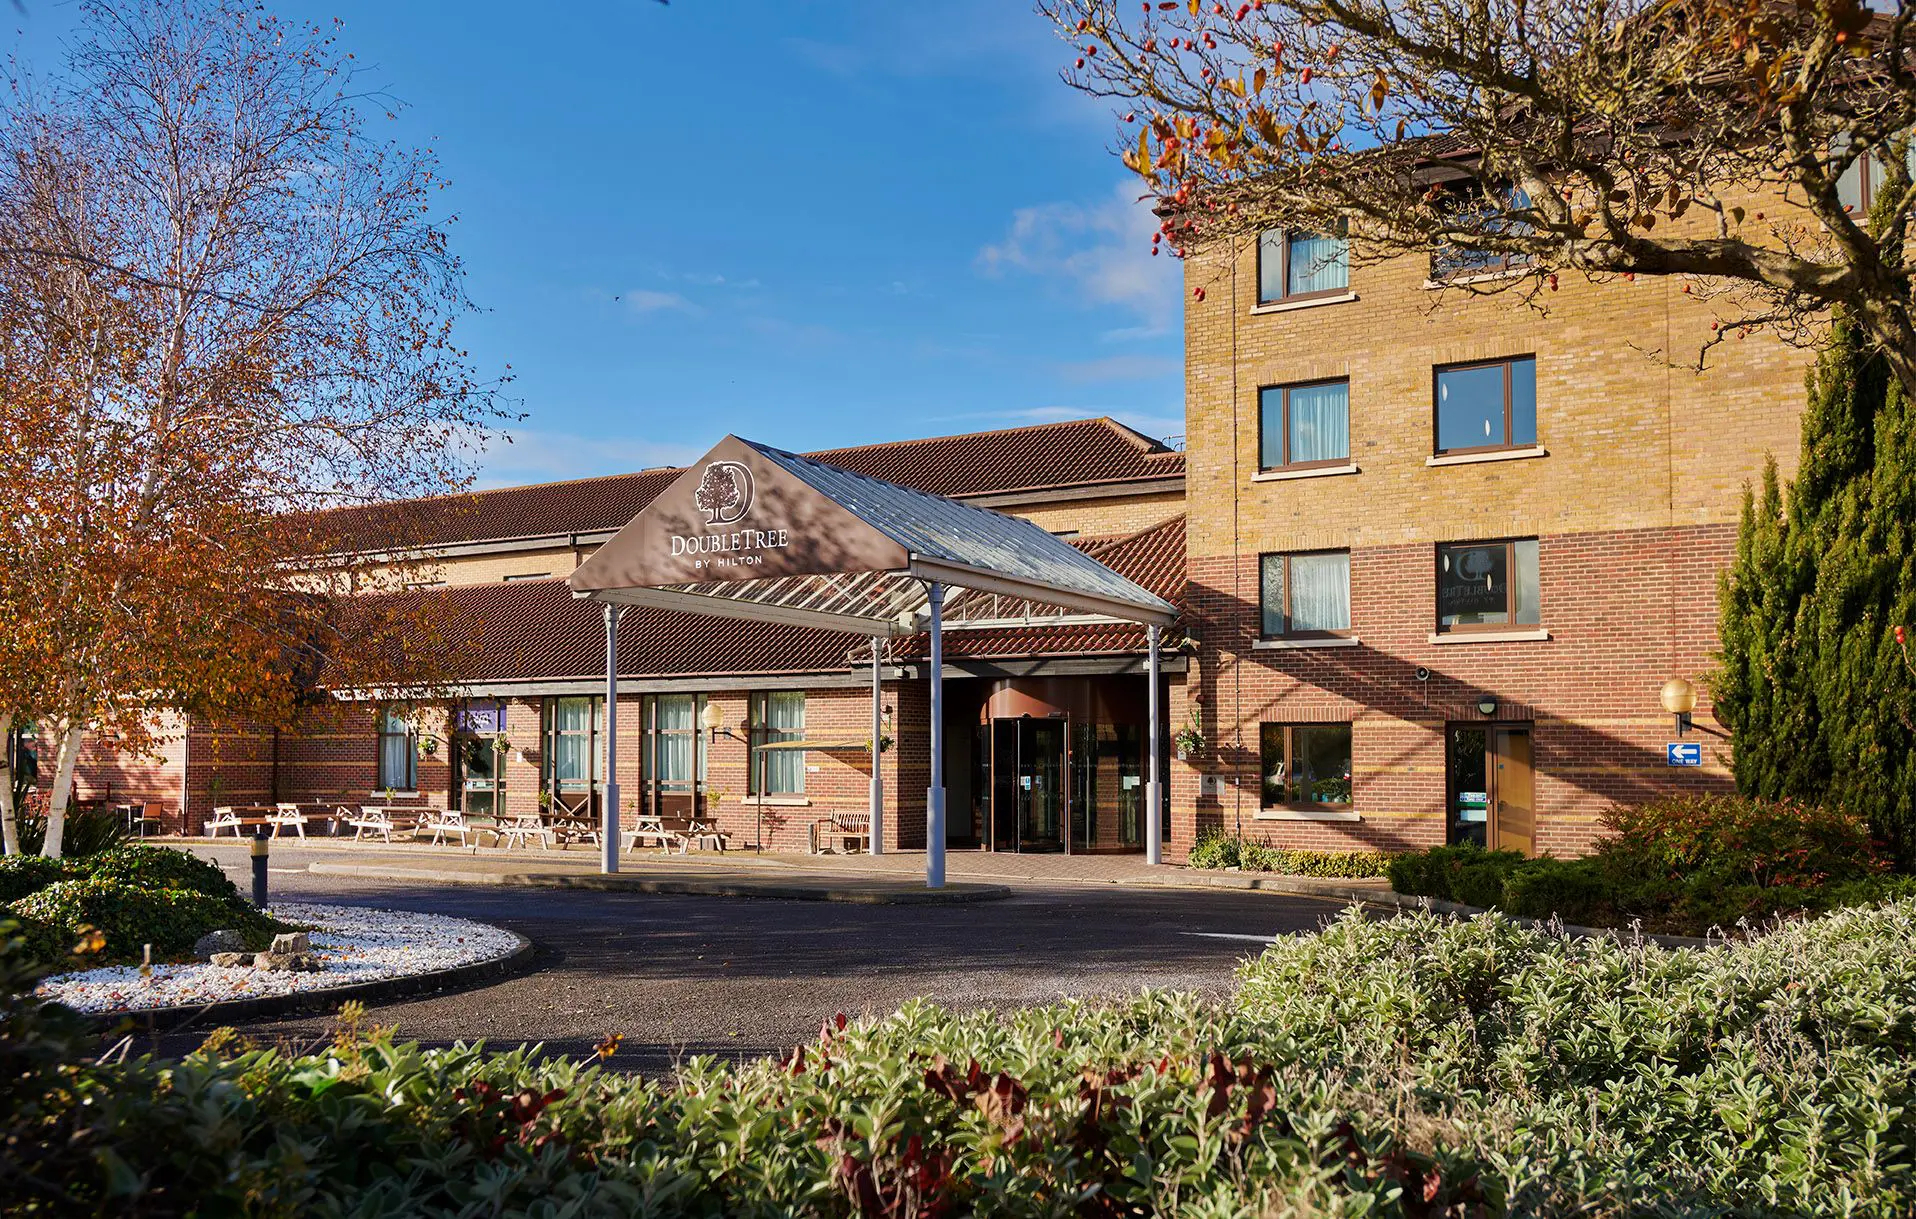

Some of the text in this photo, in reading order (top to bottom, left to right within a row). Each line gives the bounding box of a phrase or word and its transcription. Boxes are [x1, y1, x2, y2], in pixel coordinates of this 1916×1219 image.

[671, 529, 789, 556] DOUBLETREE
[695, 555, 762, 569] BY HILTON
